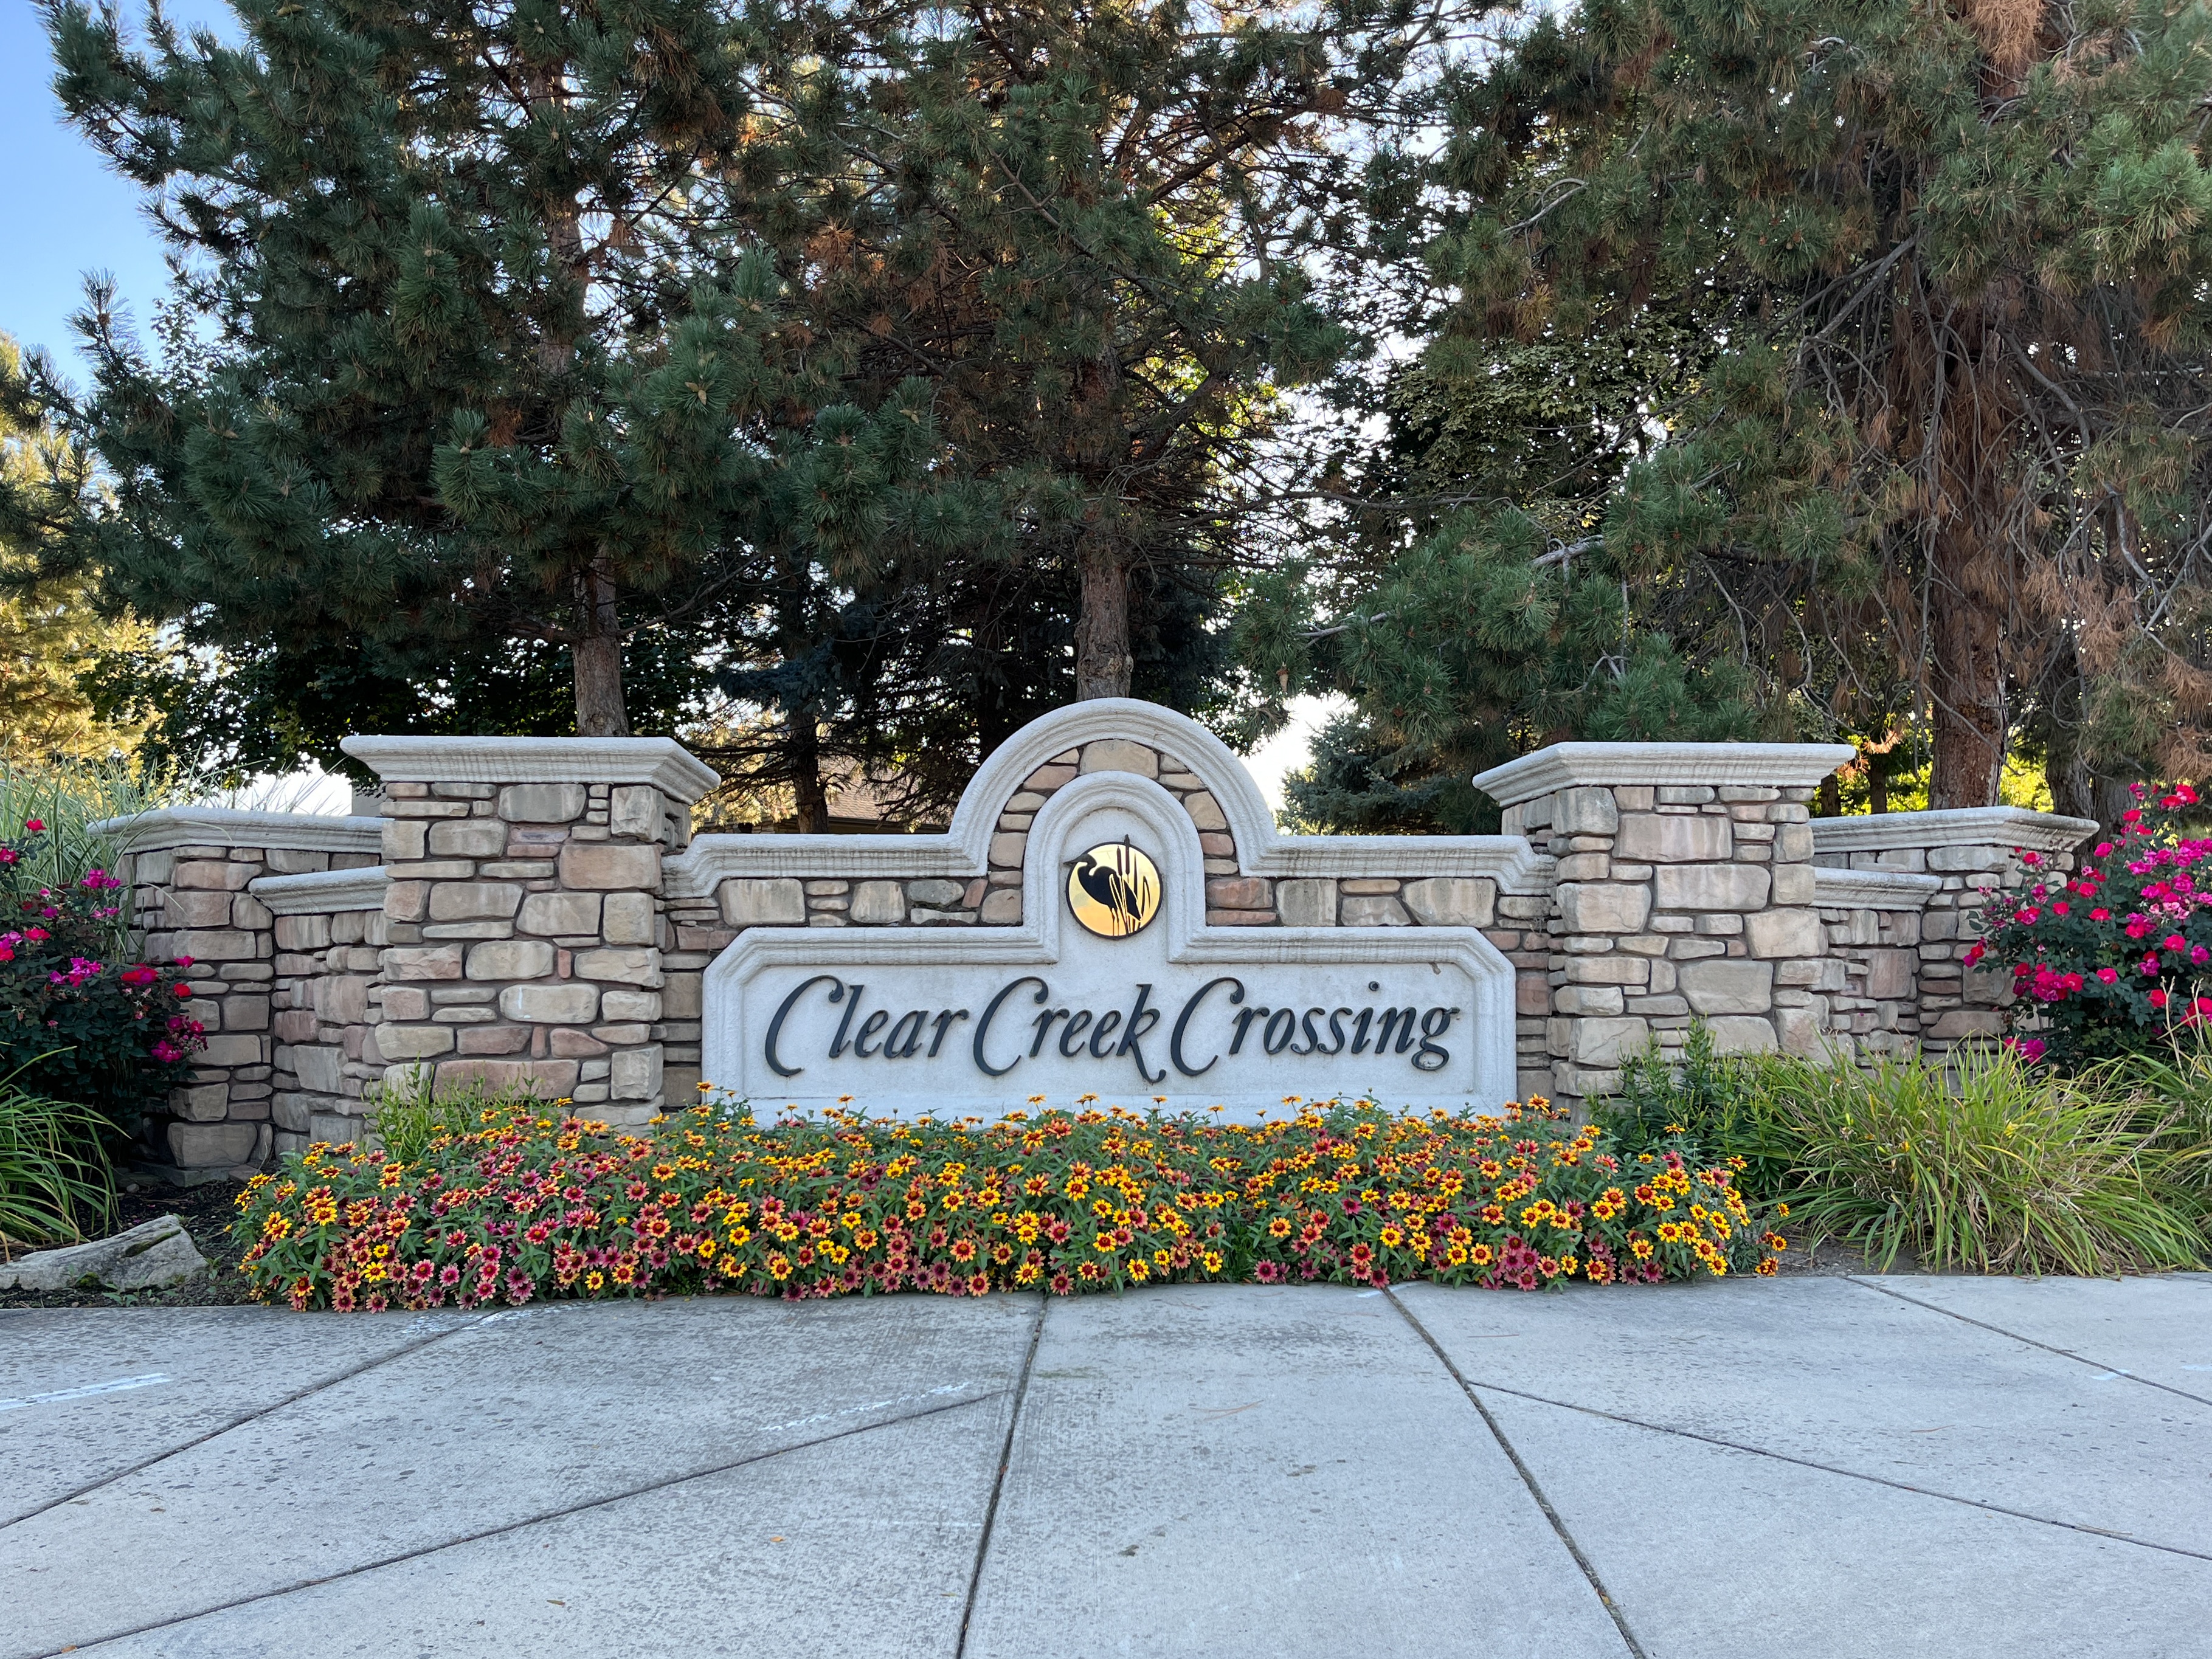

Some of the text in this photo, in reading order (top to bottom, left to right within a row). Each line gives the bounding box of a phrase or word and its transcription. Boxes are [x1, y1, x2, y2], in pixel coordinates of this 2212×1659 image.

[765, 976, 1460, 1086] Clear Creek Crossing
